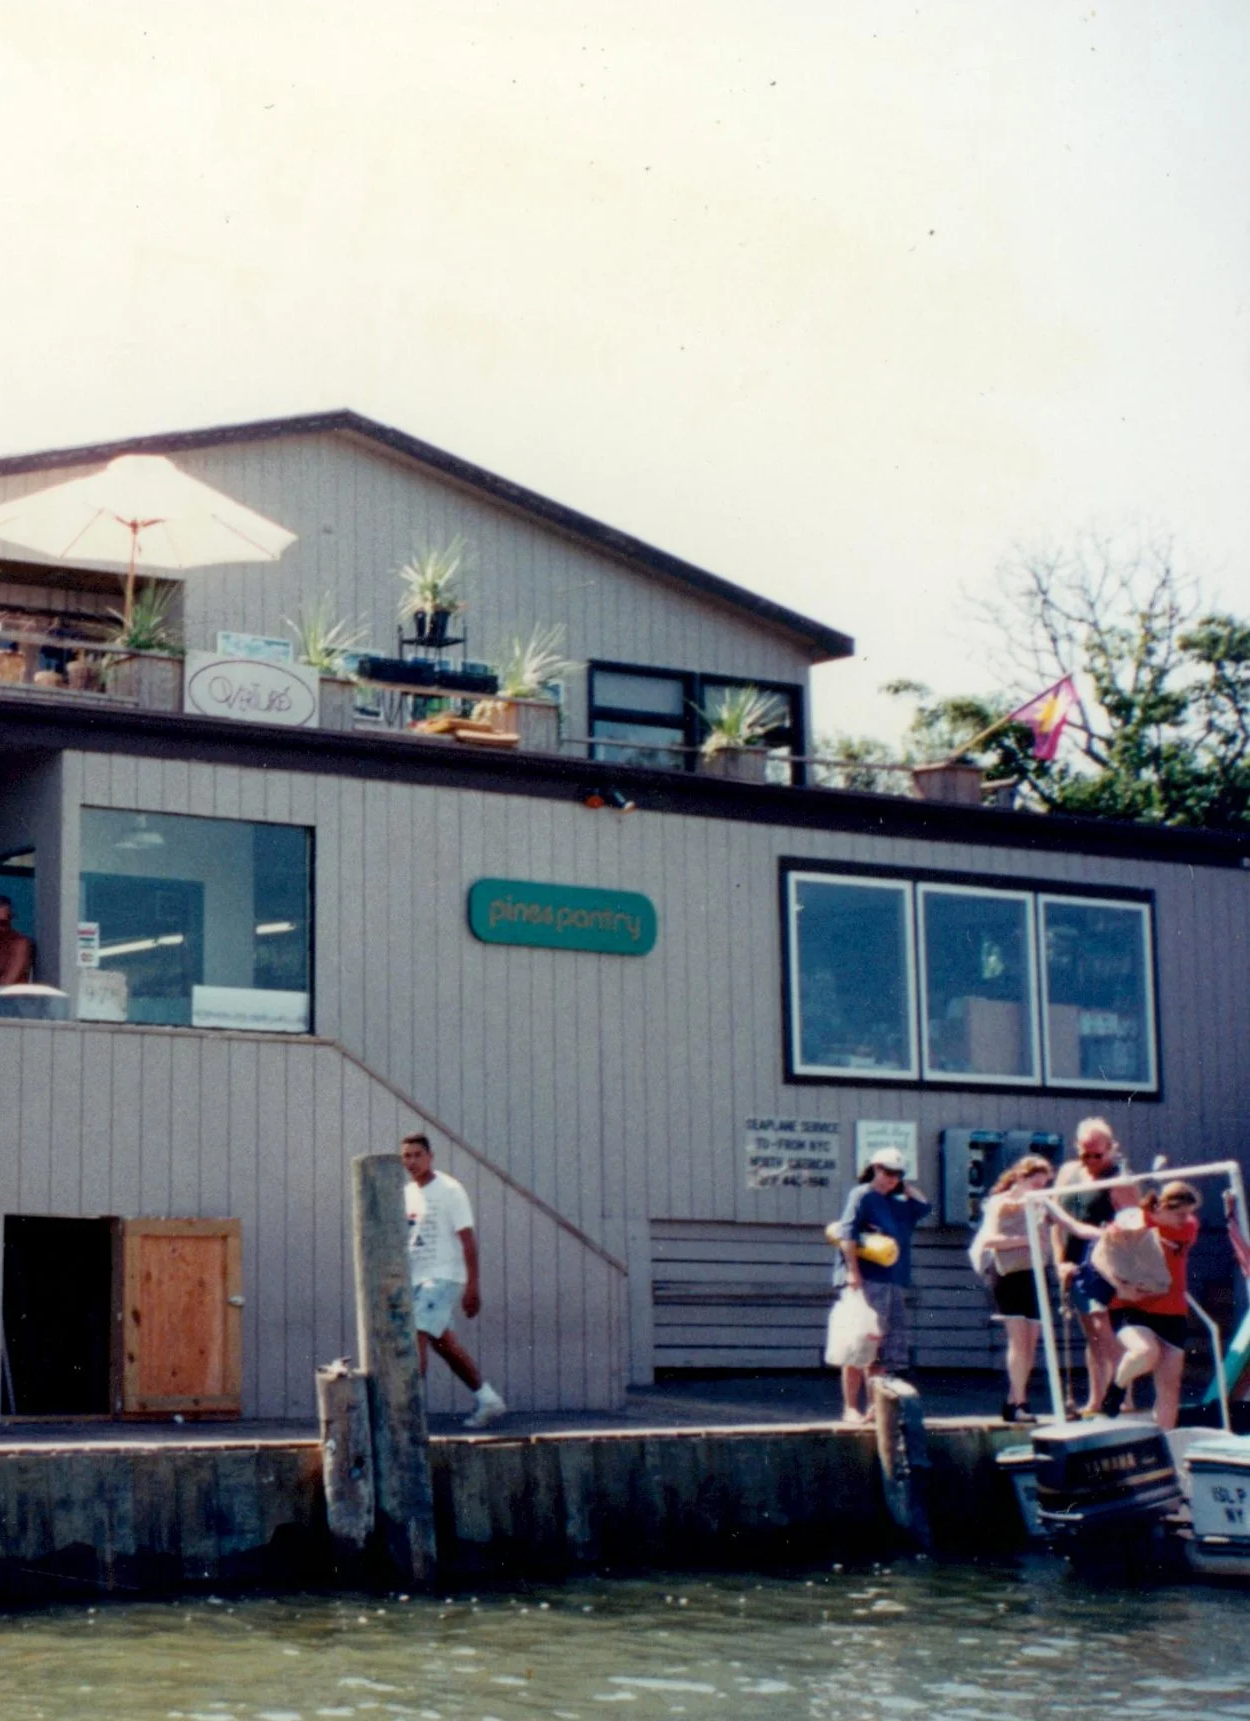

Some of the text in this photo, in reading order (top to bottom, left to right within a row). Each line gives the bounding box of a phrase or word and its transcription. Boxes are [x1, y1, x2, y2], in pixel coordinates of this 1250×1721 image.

[489, 895, 641, 941] pines pantry
[746, 1119, 839, 1134] SEAPLANE SERVICE
